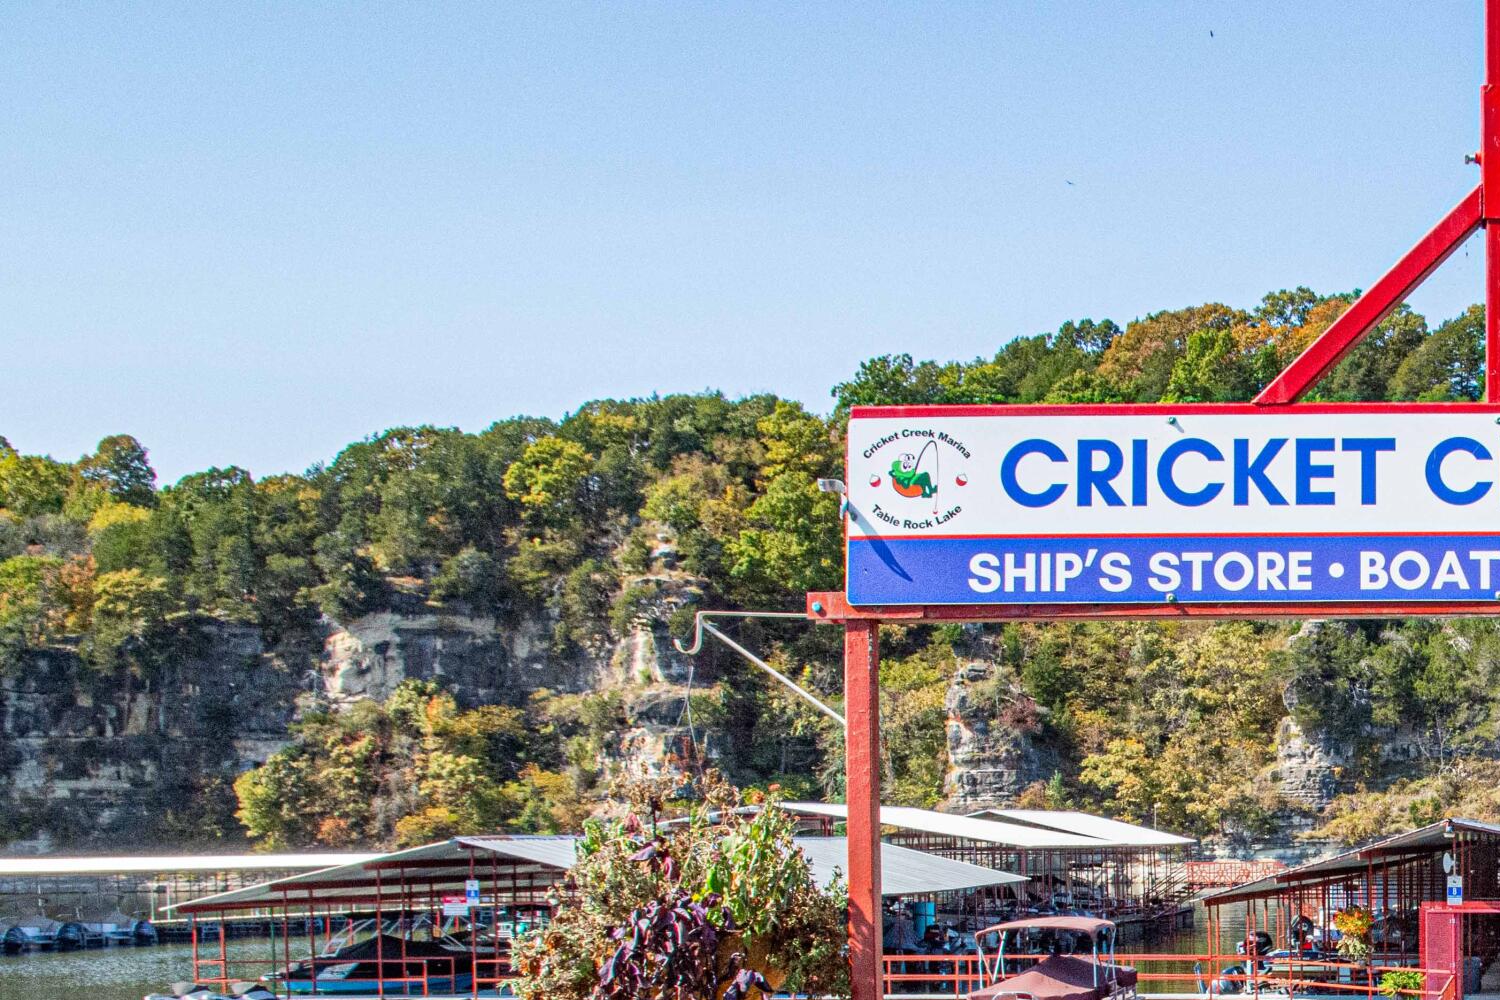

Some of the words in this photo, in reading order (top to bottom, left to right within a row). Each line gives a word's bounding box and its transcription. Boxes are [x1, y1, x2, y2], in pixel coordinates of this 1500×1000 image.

[863, 432, 900, 460] Cricket
[902, 429, 935, 439] Creek
[938, 432, 971, 459] Marina
[1000, 437, 1397, 508] CRICKET
[872, 504, 900, 527] Table
[903, 519, 933, 529] Rock
[935, 505, 962, 525] Lake
[967, 548, 1133, 593] SHIP'S
[1147, 551, 1313, 592] STORE
[1359, 550, 1500, 591] BOAT
